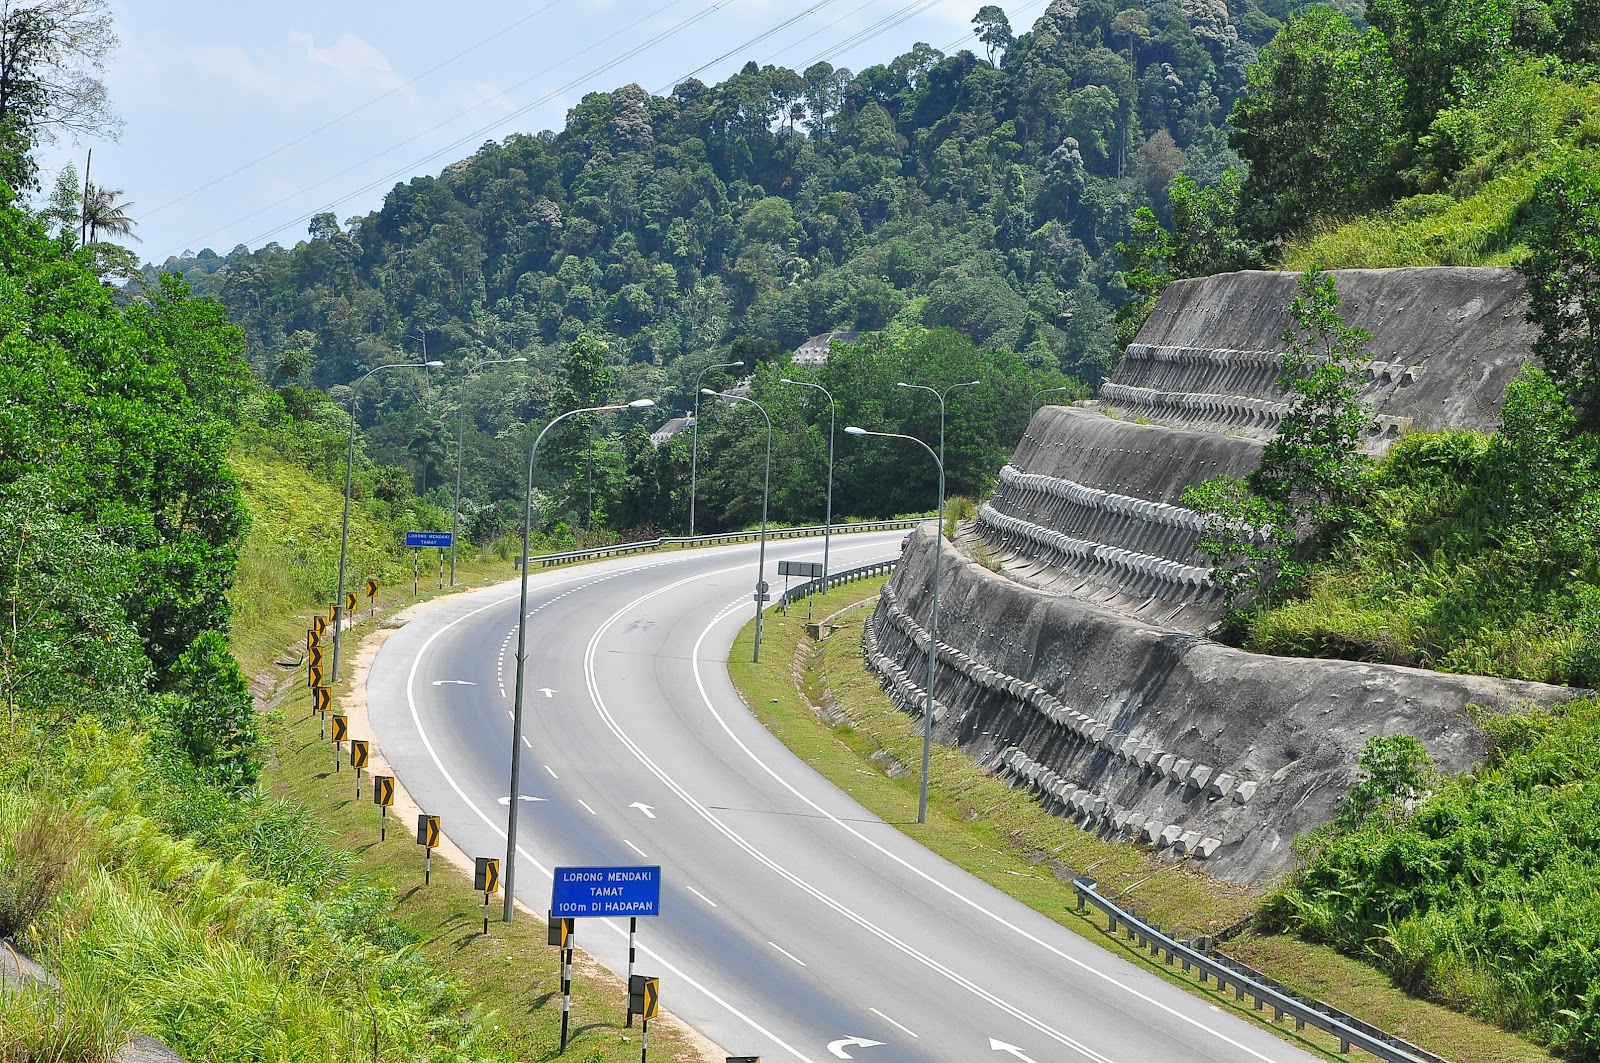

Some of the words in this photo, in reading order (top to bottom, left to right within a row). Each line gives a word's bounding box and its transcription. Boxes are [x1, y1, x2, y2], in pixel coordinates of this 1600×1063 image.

[563, 872, 603, 882] LORONG
[608, 871, 652, 882] MENDAKI
[590, 887, 624, 896] TAMAT
[559, 902, 587, 912] 100m
[592, 902, 602, 912] DI
[605, 902, 653, 911] HADAPAN
